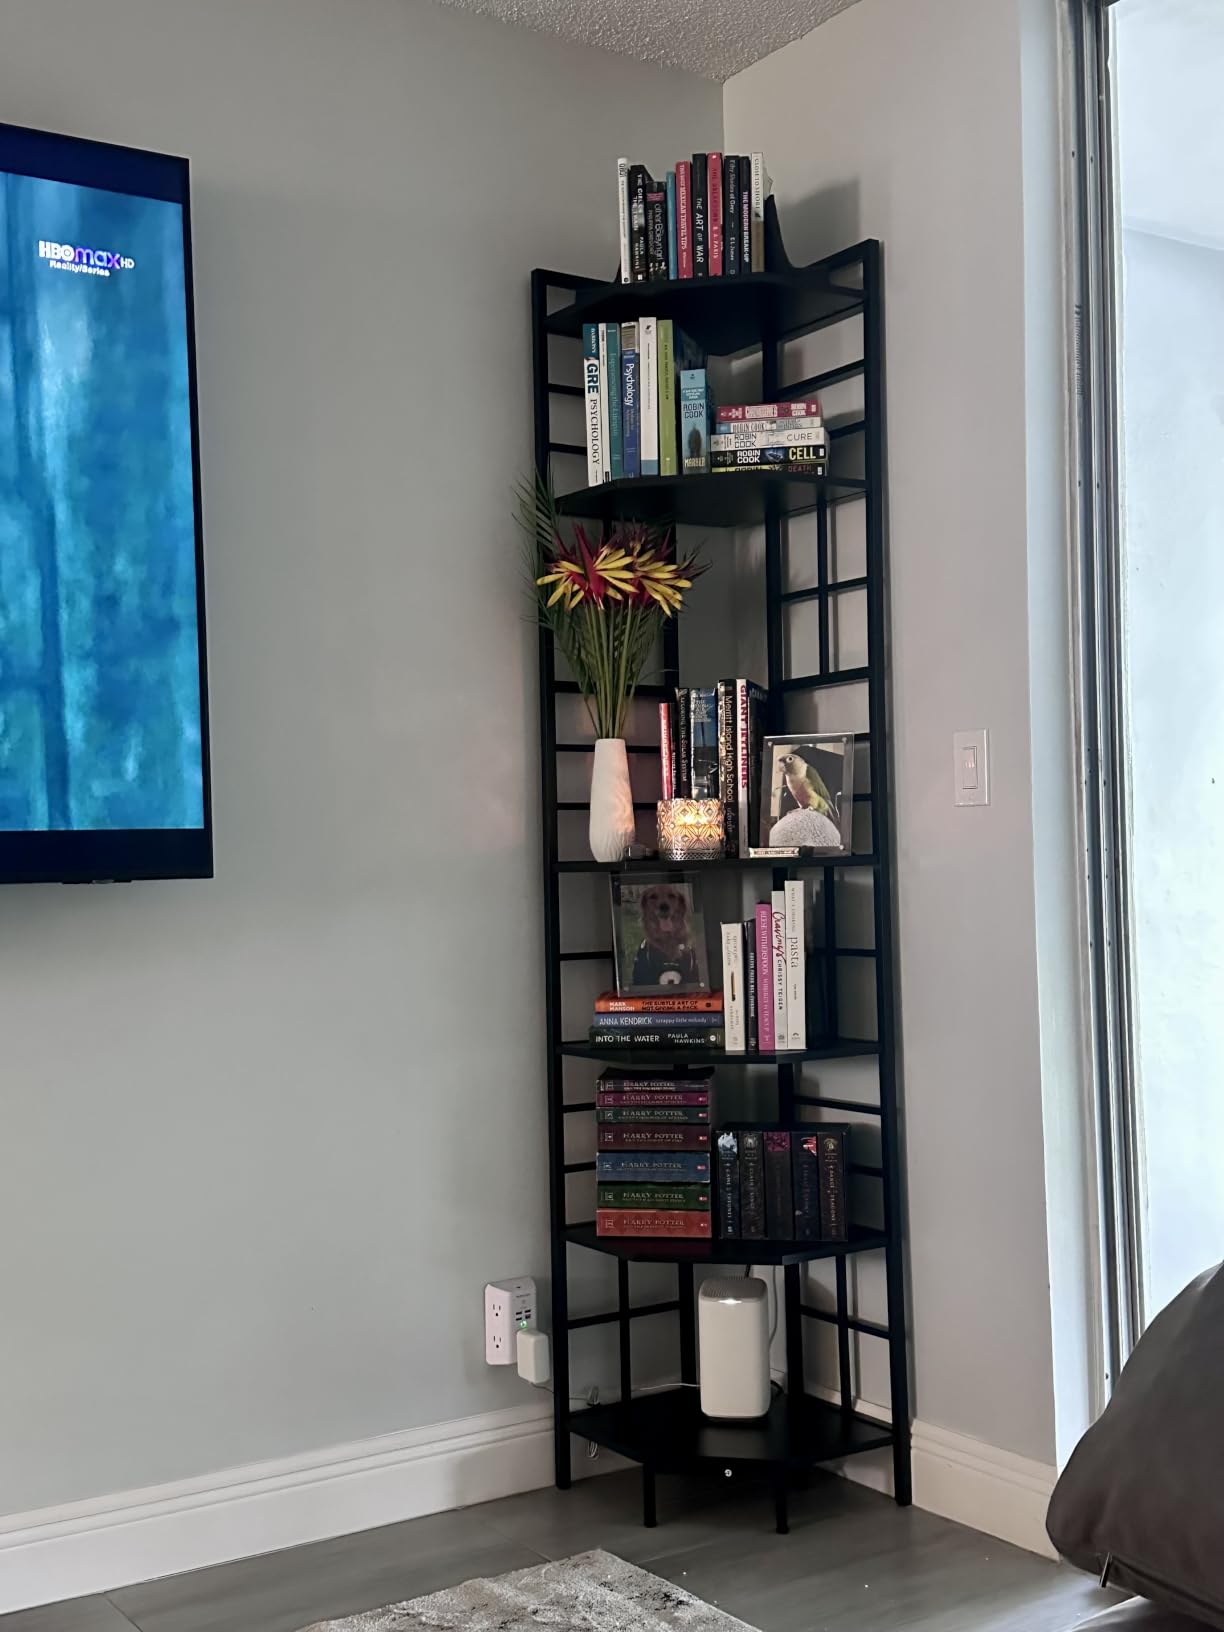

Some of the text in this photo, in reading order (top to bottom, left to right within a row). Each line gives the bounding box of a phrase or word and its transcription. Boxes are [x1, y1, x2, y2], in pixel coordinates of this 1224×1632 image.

[696, 213, 704, 230] ART
[697, 233, 702, 241] OF
[624, 363, 635, 406] Psychology
[587, 364, 600, 465] GRE PSYCHOLOGY
[683, 403, 704, 411] ROBIN
[684, 411, 704, 419] COOK
[735, 433, 757, 441] ROBIN
[787, 433, 813, 442] CURE
[735, 441, 757, 449] COOK
[737, 449, 761, 457] ROBIN
[737, 456, 761, 464] COOK
[789, 447, 817, 461] CELL
[725, 695, 733, 723] Merritt
[725, 725, 734, 750] Island
[726, 752, 735, 772] High
[726, 774, 735, 802] School
[772, 911, 786, 960] Cravings
[761, 930, 769, 975] WITHERSPOON
[787, 937, 802, 968] pasta
[599, 1016, 653, 1025] ANNA KENDRICK
